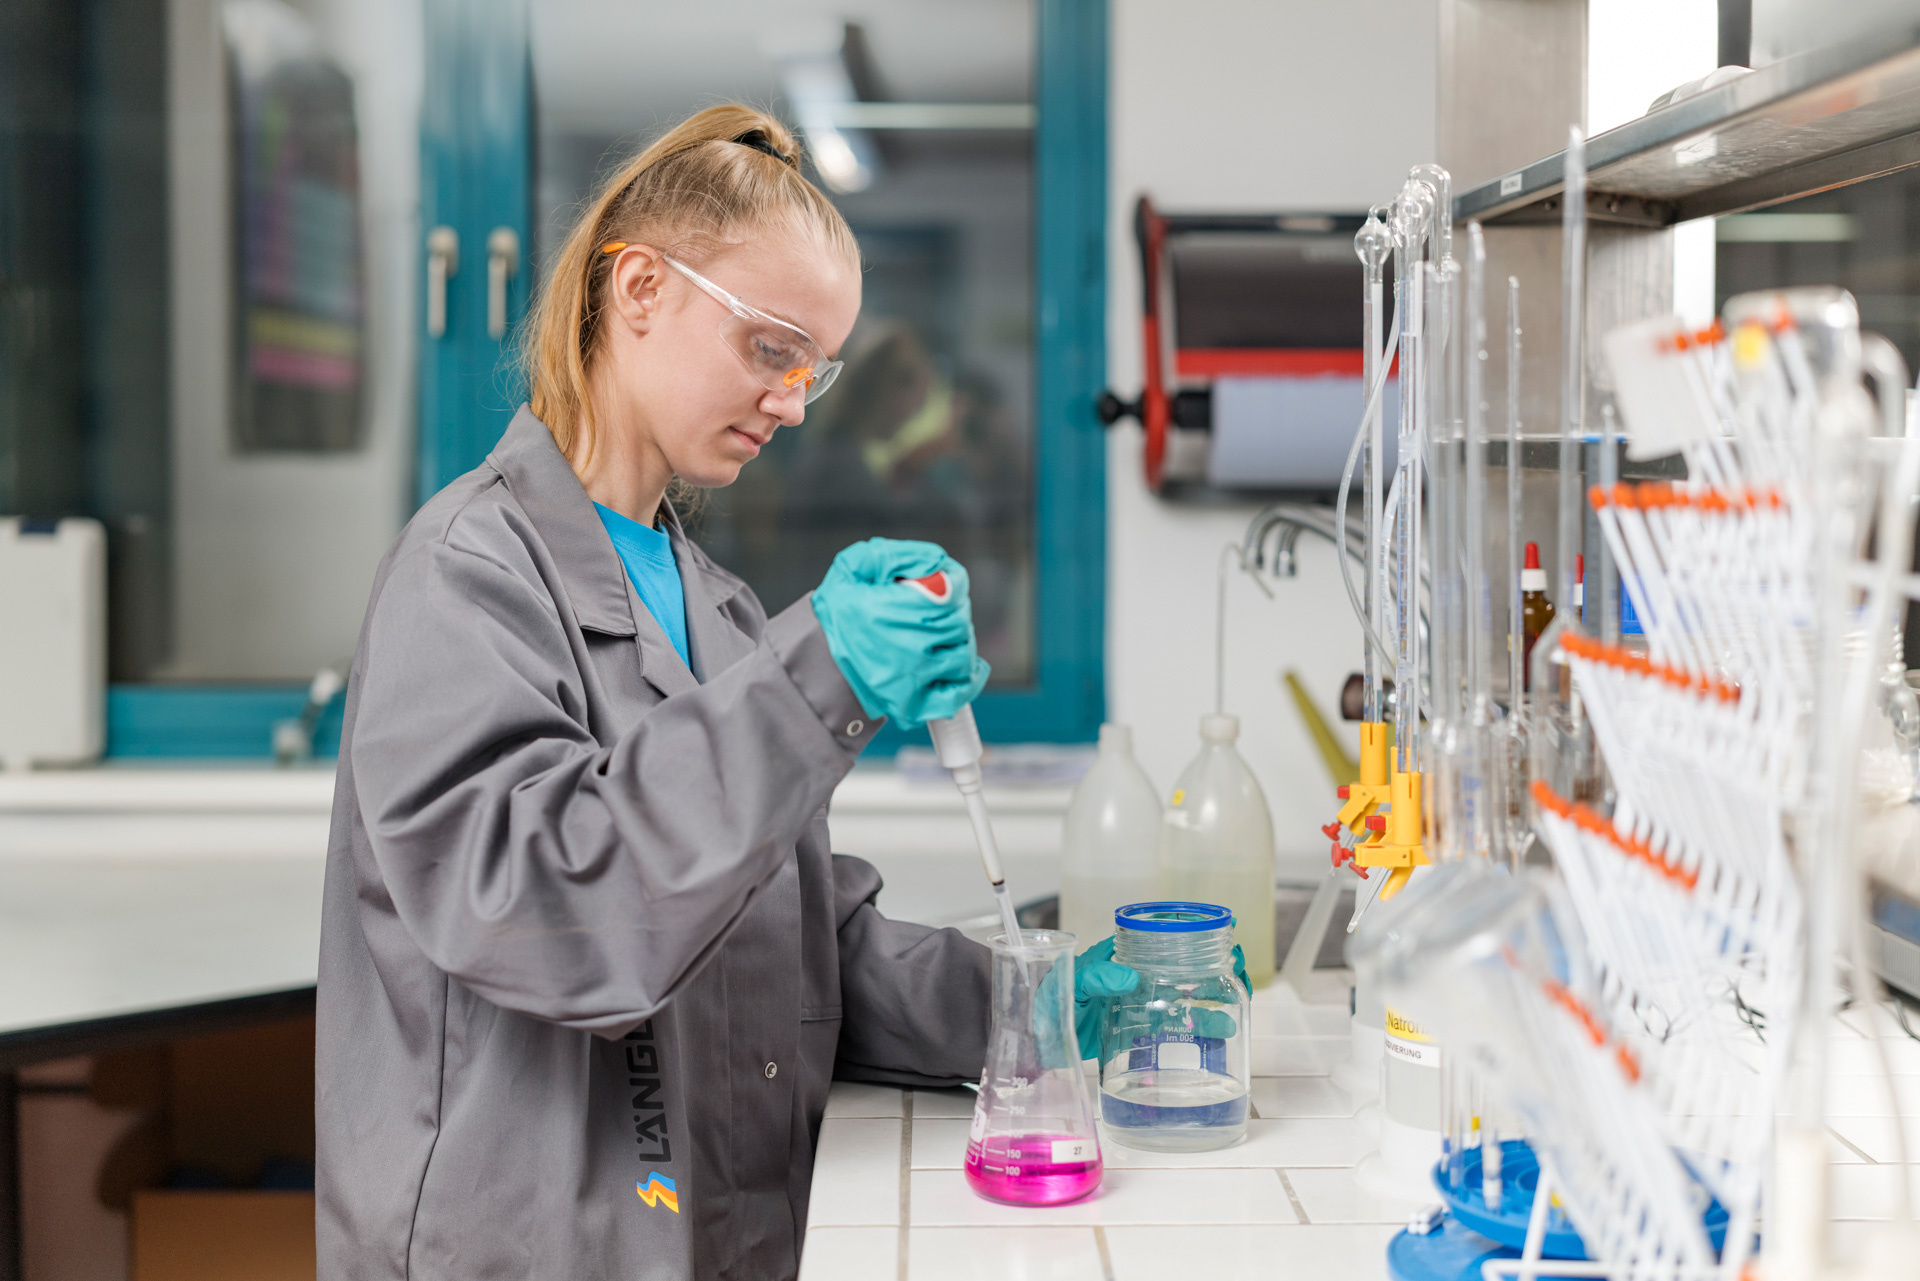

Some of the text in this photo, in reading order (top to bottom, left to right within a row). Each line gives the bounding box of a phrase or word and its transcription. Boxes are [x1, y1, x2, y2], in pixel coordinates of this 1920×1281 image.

[1011, 1076, 1028, 1087] 300
[1009, 1106, 1026, 1115] 250
[1006, 1149, 1021, 1159] 150
[1074, 1146, 1082, 1155] 27
[1005, 1166, 1020, 1176] 100
